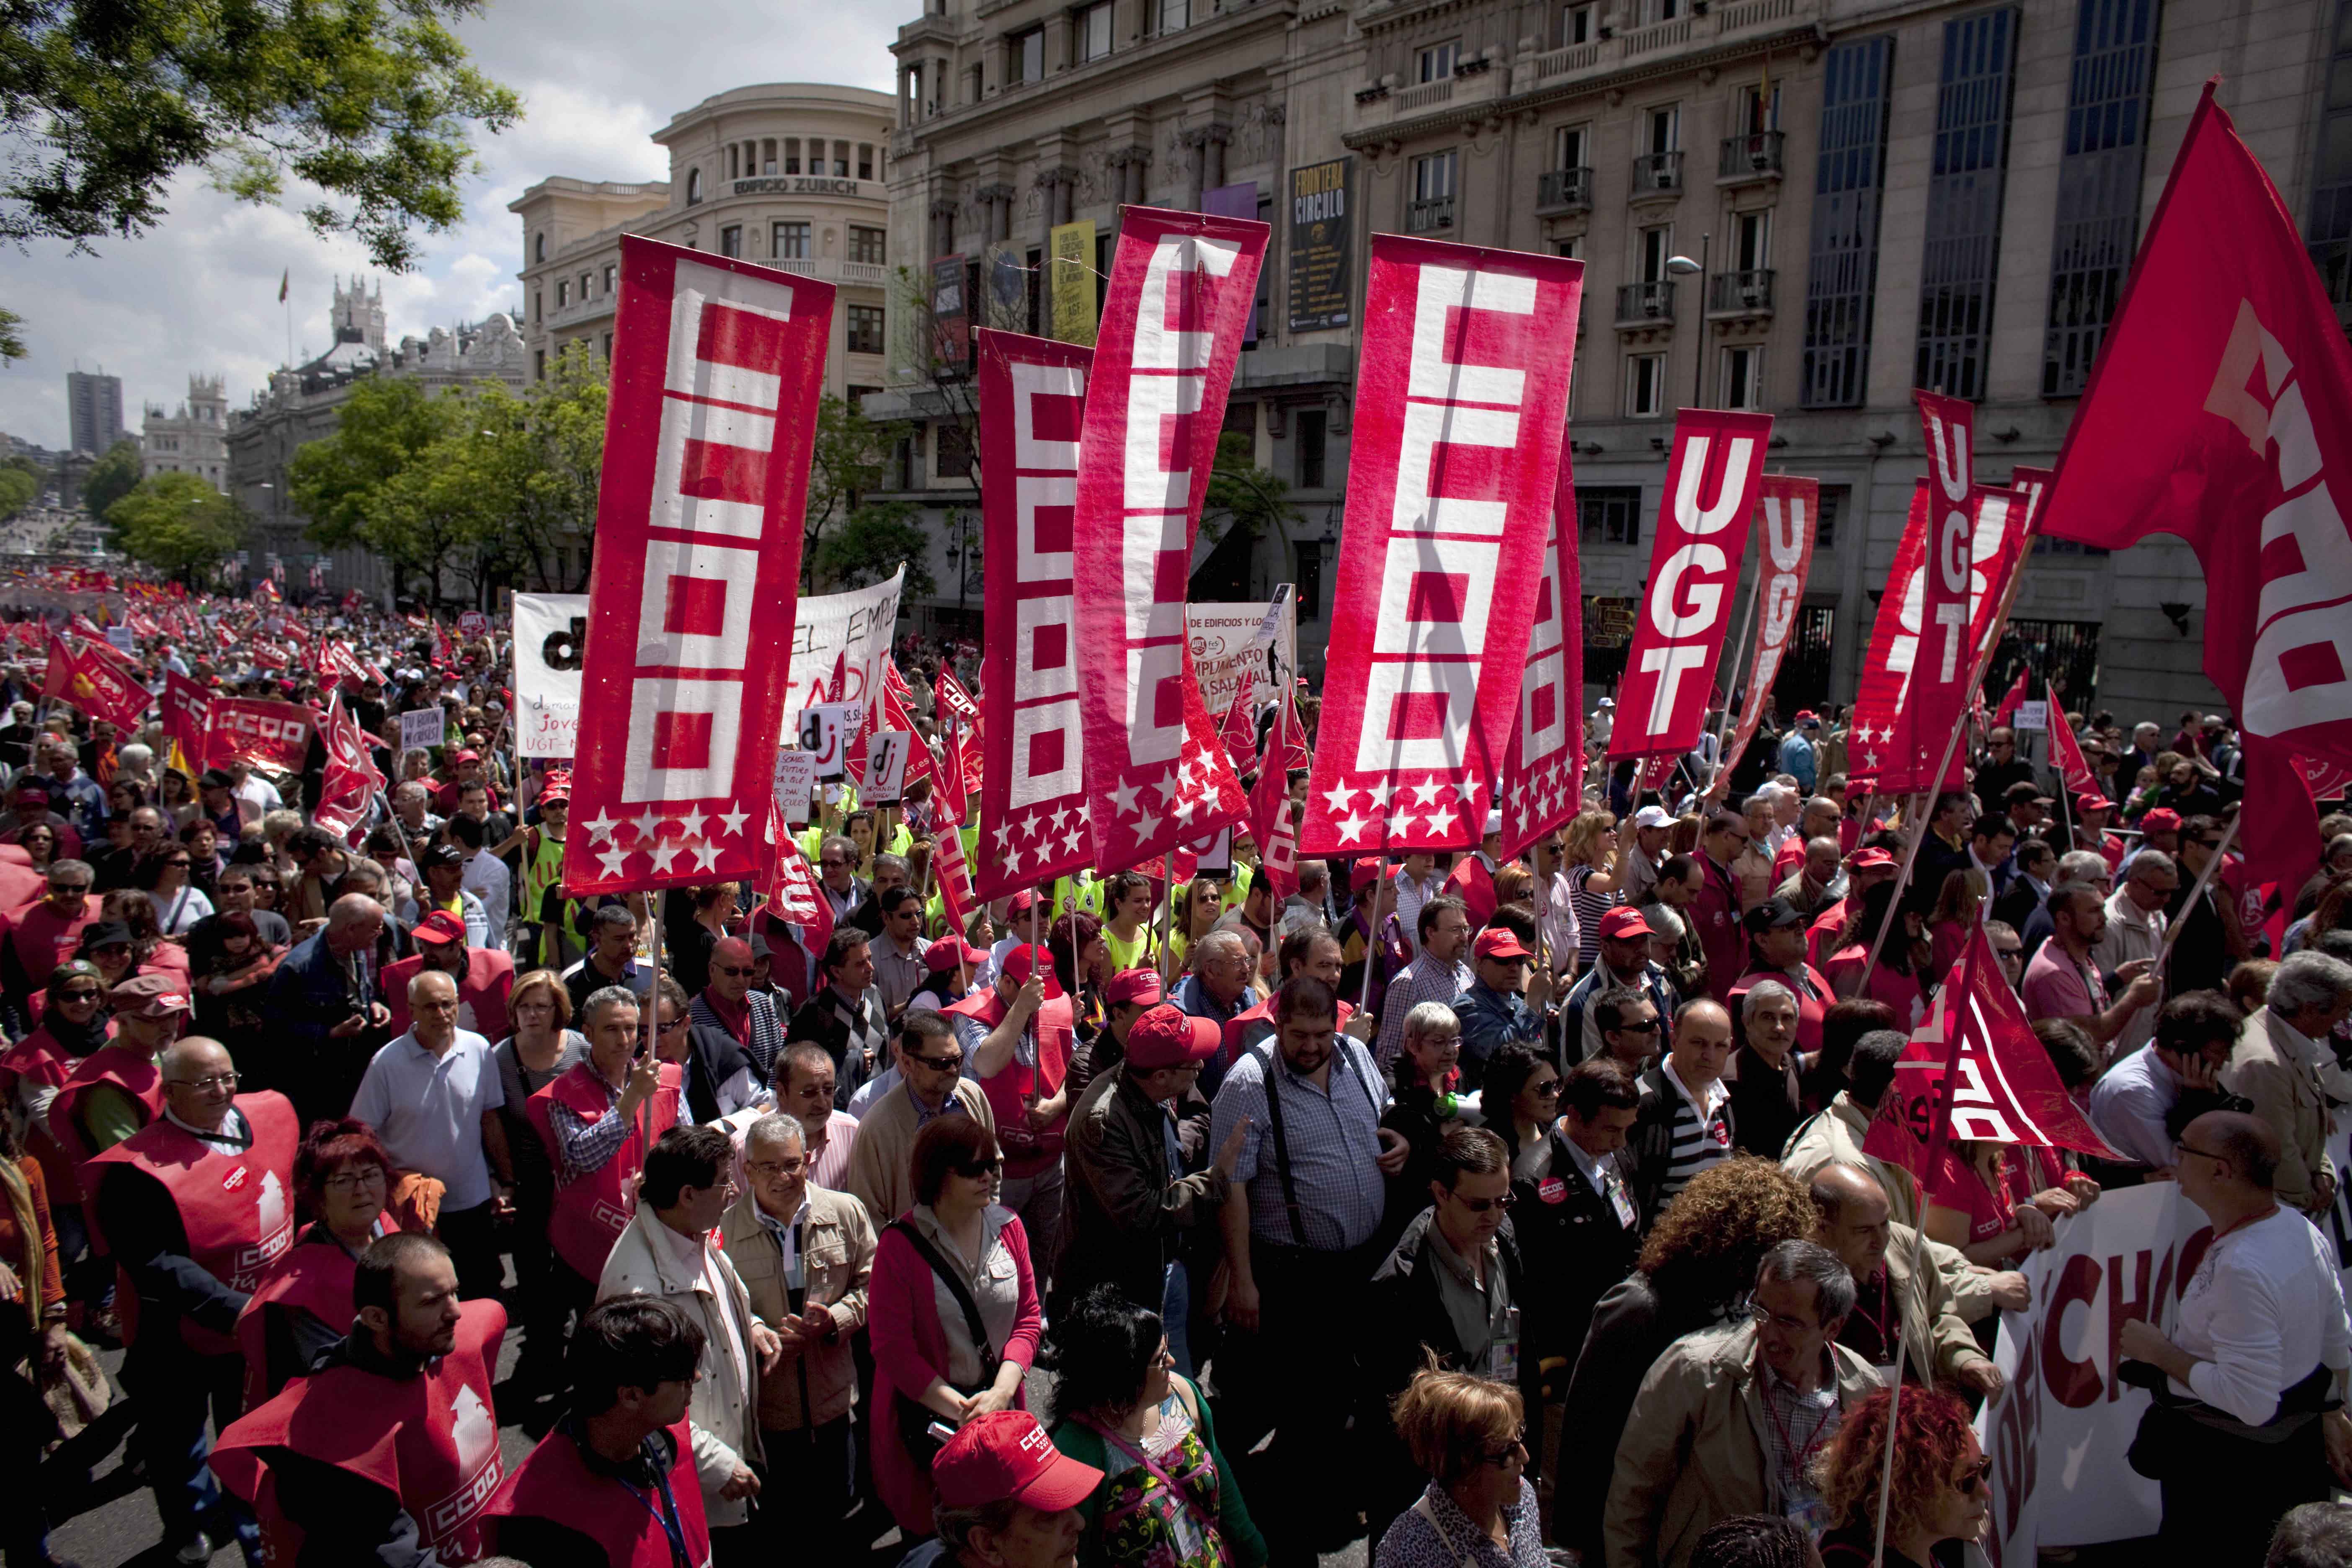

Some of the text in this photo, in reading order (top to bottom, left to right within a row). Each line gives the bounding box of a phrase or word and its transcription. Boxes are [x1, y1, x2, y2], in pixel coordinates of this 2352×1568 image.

[734, 179, 857, 194] EDIFICIO ZURICH
[1295, 161, 1344, 197] FRONTERA
[1295, 188, 1344, 224] CIRCULO
[621, 257, 794, 803] CCOO
[1355, 264, 1537, 773] CCOO
[1931, 415, 1968, 684] UGT
[1639, 436, 1754, 736] UGT
[462, 615, 483, 625] UGT
[1190, 619, 1202, 627] DE
[1204, 618, 1242, 627] EDIFICIOS
[1244, 618, 1250, 626] Y
[1745, 498, 1805, 728] UGT
[332, 645, 369, 681] CCOO
[218, 711, 306, 743] CCOO
[223, 1166, 247, 1190] CCOO
[1538, 1182, 1564, 1196] CCOO
[1977, 1219, 2001, 1233] CCOO
[242, 1230, 287, 1266] CCOO
[435, 1462, 498, 1530] CCOO
